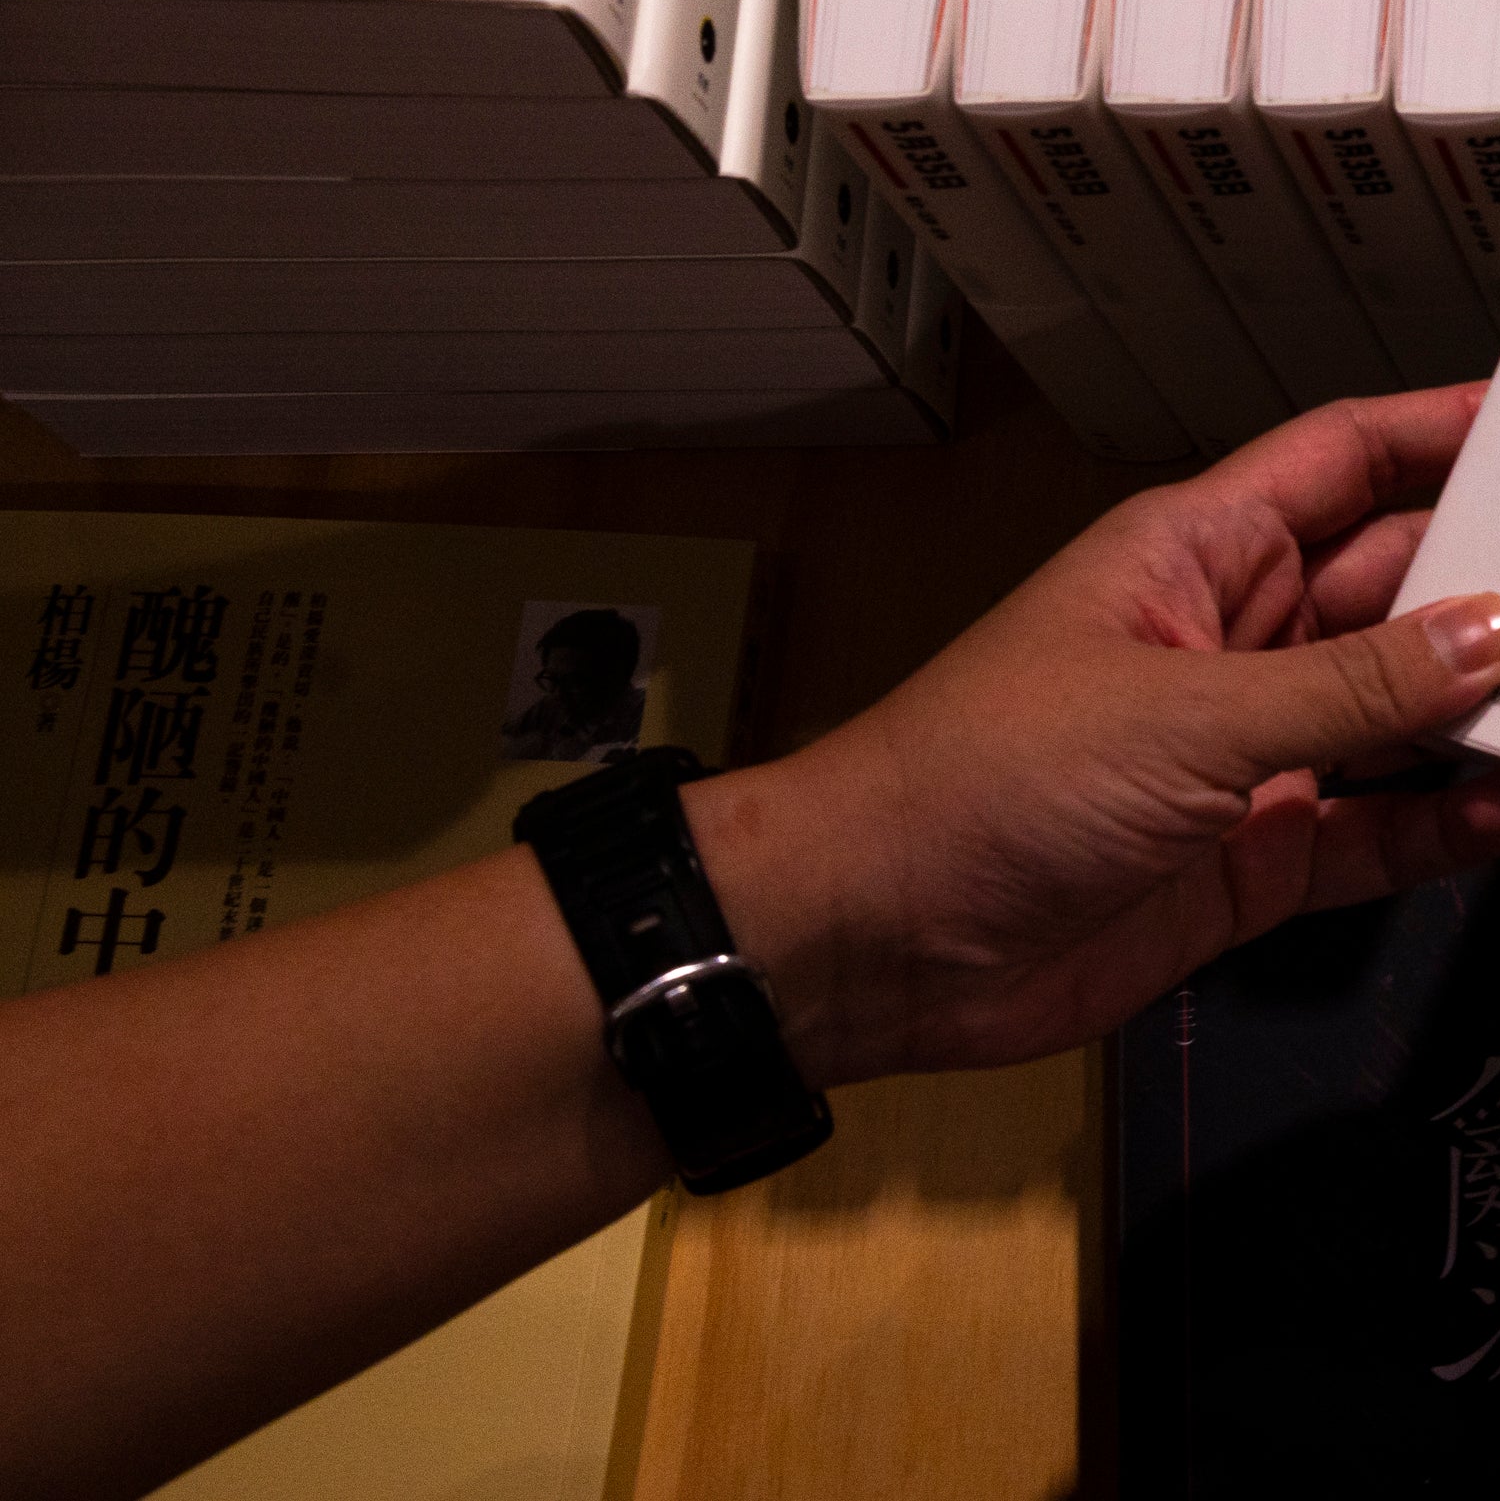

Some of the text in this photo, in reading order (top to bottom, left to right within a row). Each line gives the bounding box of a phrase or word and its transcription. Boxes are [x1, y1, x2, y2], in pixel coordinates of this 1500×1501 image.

[25, 583, 95, 692] 柏楊
[57, 583, 231, 978] 醜陋的中
